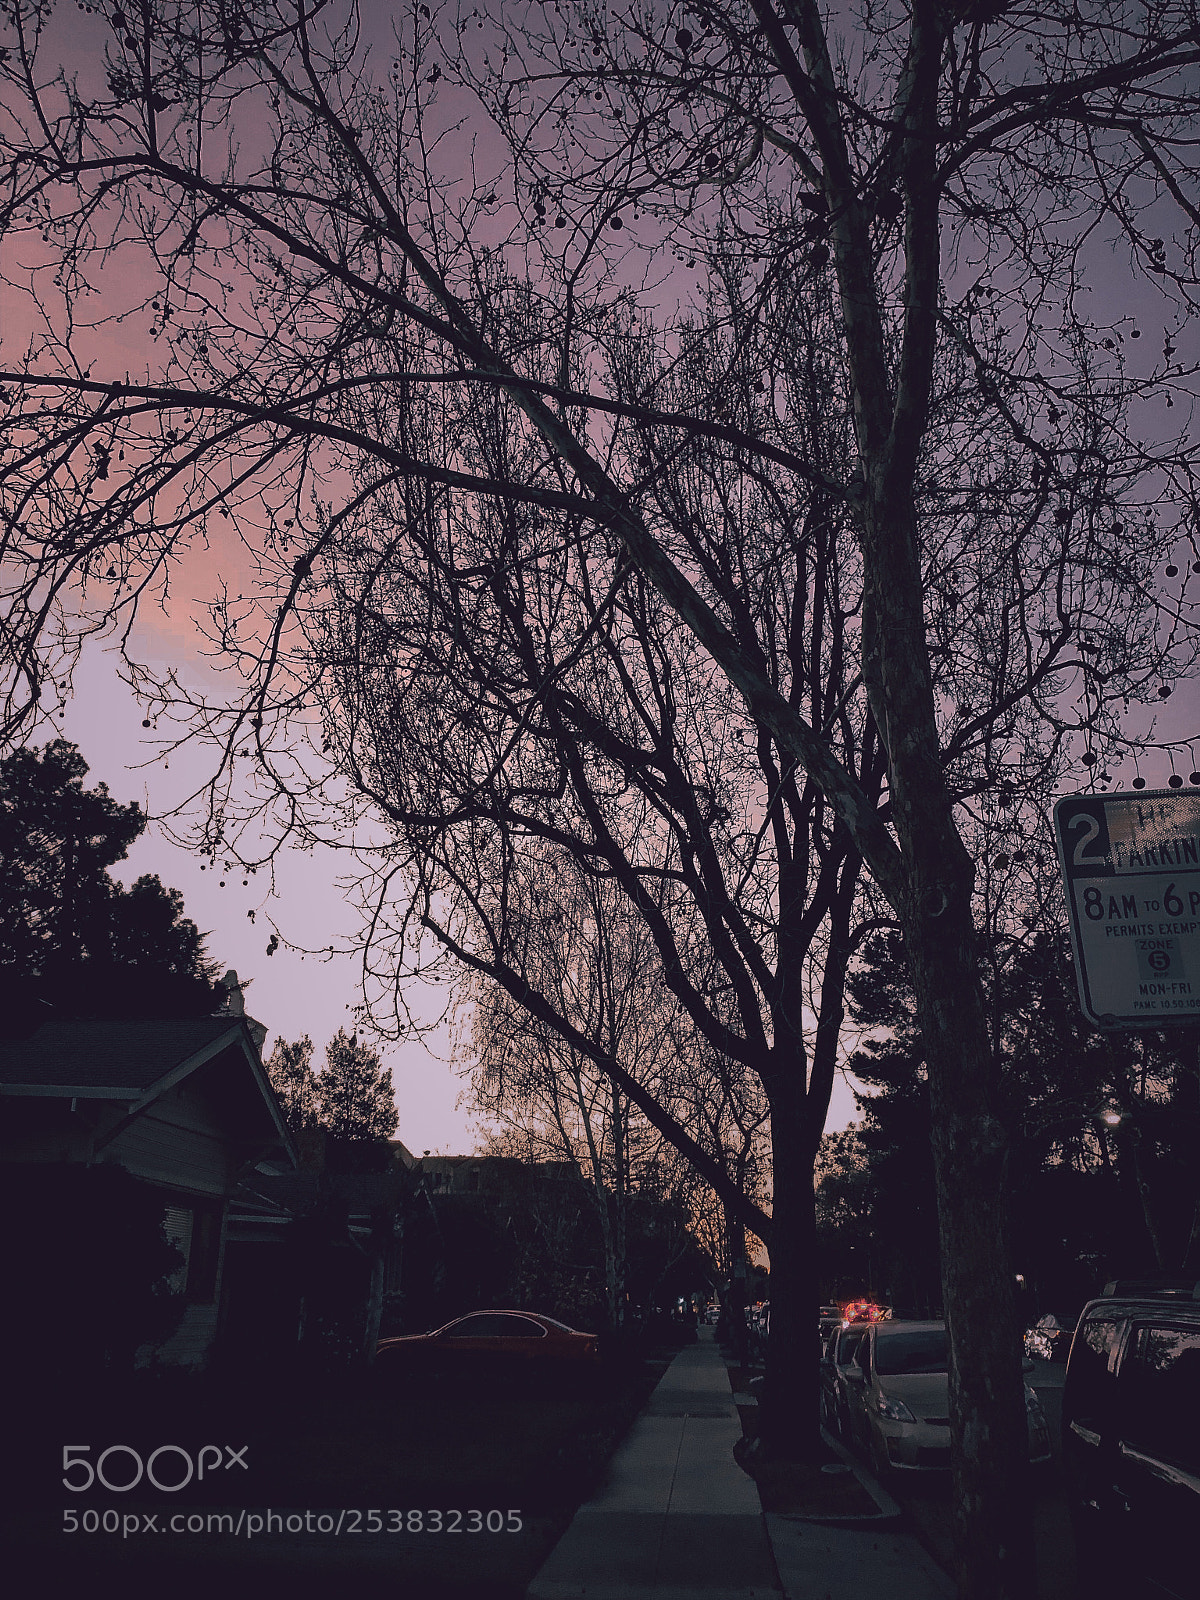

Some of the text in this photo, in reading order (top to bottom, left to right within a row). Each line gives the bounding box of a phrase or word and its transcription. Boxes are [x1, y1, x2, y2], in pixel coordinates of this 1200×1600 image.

[1068, 813, 1106, 866] 2
[1114, 836, 1200, 868] PARKIN
[1144, 900, 1160, 912] TO
[1105, 921, 1200, 937] PERMITS EXEMP
[1139, 939, 1174, 951] ZONE
[1138, 982, 1192, 996] MON-FRI
